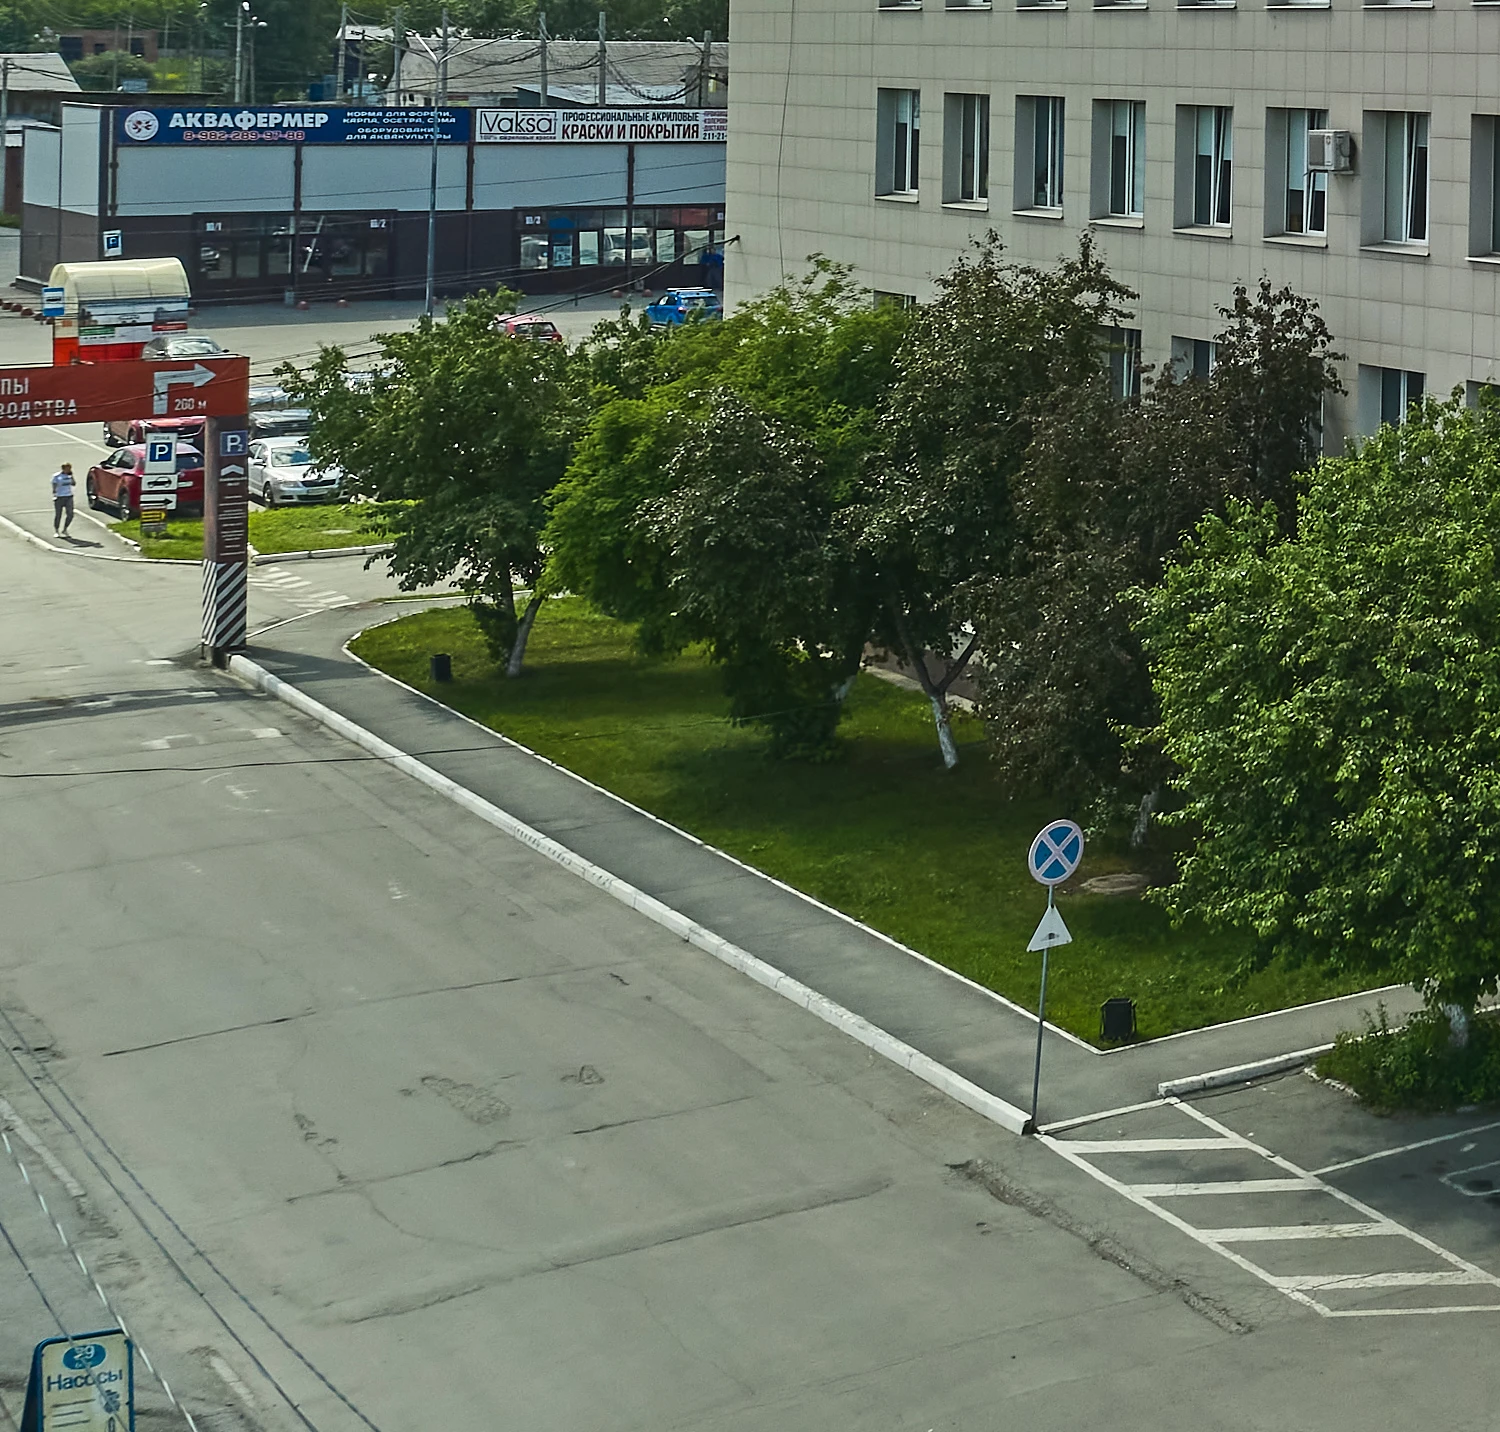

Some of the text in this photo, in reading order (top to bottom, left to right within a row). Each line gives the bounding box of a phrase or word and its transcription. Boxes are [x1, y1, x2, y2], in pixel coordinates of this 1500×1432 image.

[168, 110, 329, 131] АКВАФЕРМЕР
[483, 110, 553, 133] Vaksa
[562, 111, 650, 122] ПРОФЕССИОНАЛЬНЫЕ
[651, 111, 700, 122] АКРИЛОВЫЕ
[562, 123, 699, 140] КРАСКИ И ПОКРЫТИЯ
[47, 1369, 123, 1392] Насосы
